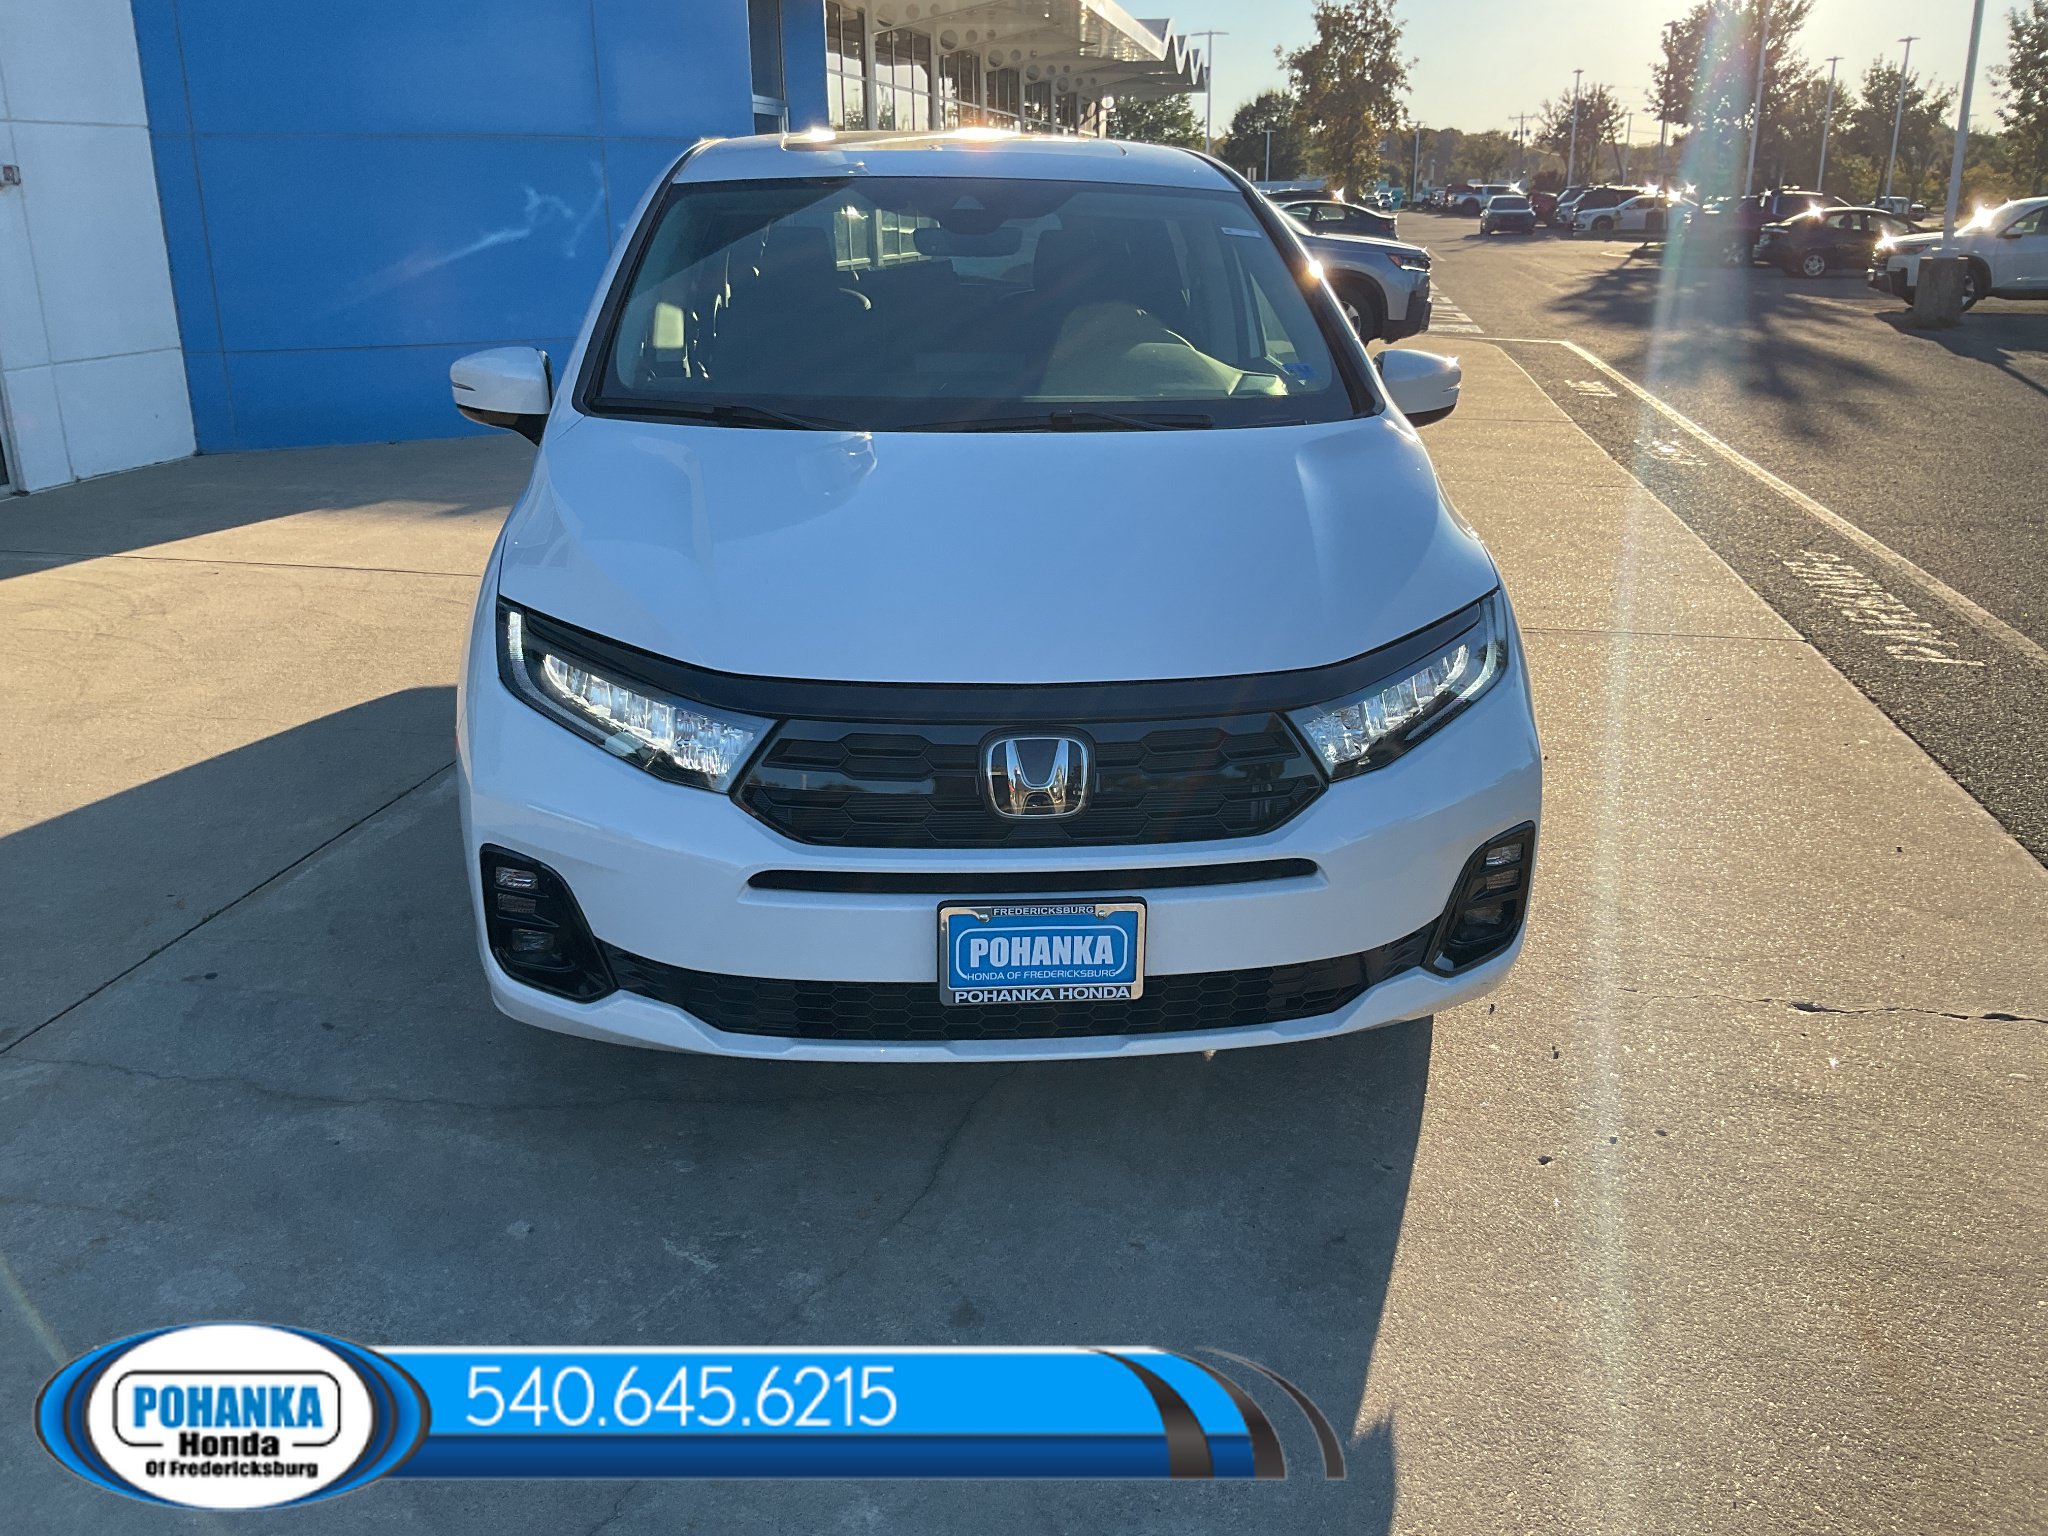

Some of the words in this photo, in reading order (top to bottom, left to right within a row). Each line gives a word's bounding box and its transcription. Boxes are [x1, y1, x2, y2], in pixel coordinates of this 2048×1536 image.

[993, 906, 1095, 916] FREDERICKSBURG
[970, 935, 1114, 968] POHANKA
[967, 972, 1004, 981] HONDA
[1007, 971, 1022, 980] OF
[1023, 969, 1116, 980] FREDERICKSBURG
[954, 988, 1054, 1004] POHANKA
[1059, 986, 1131, 1000] HONDA
